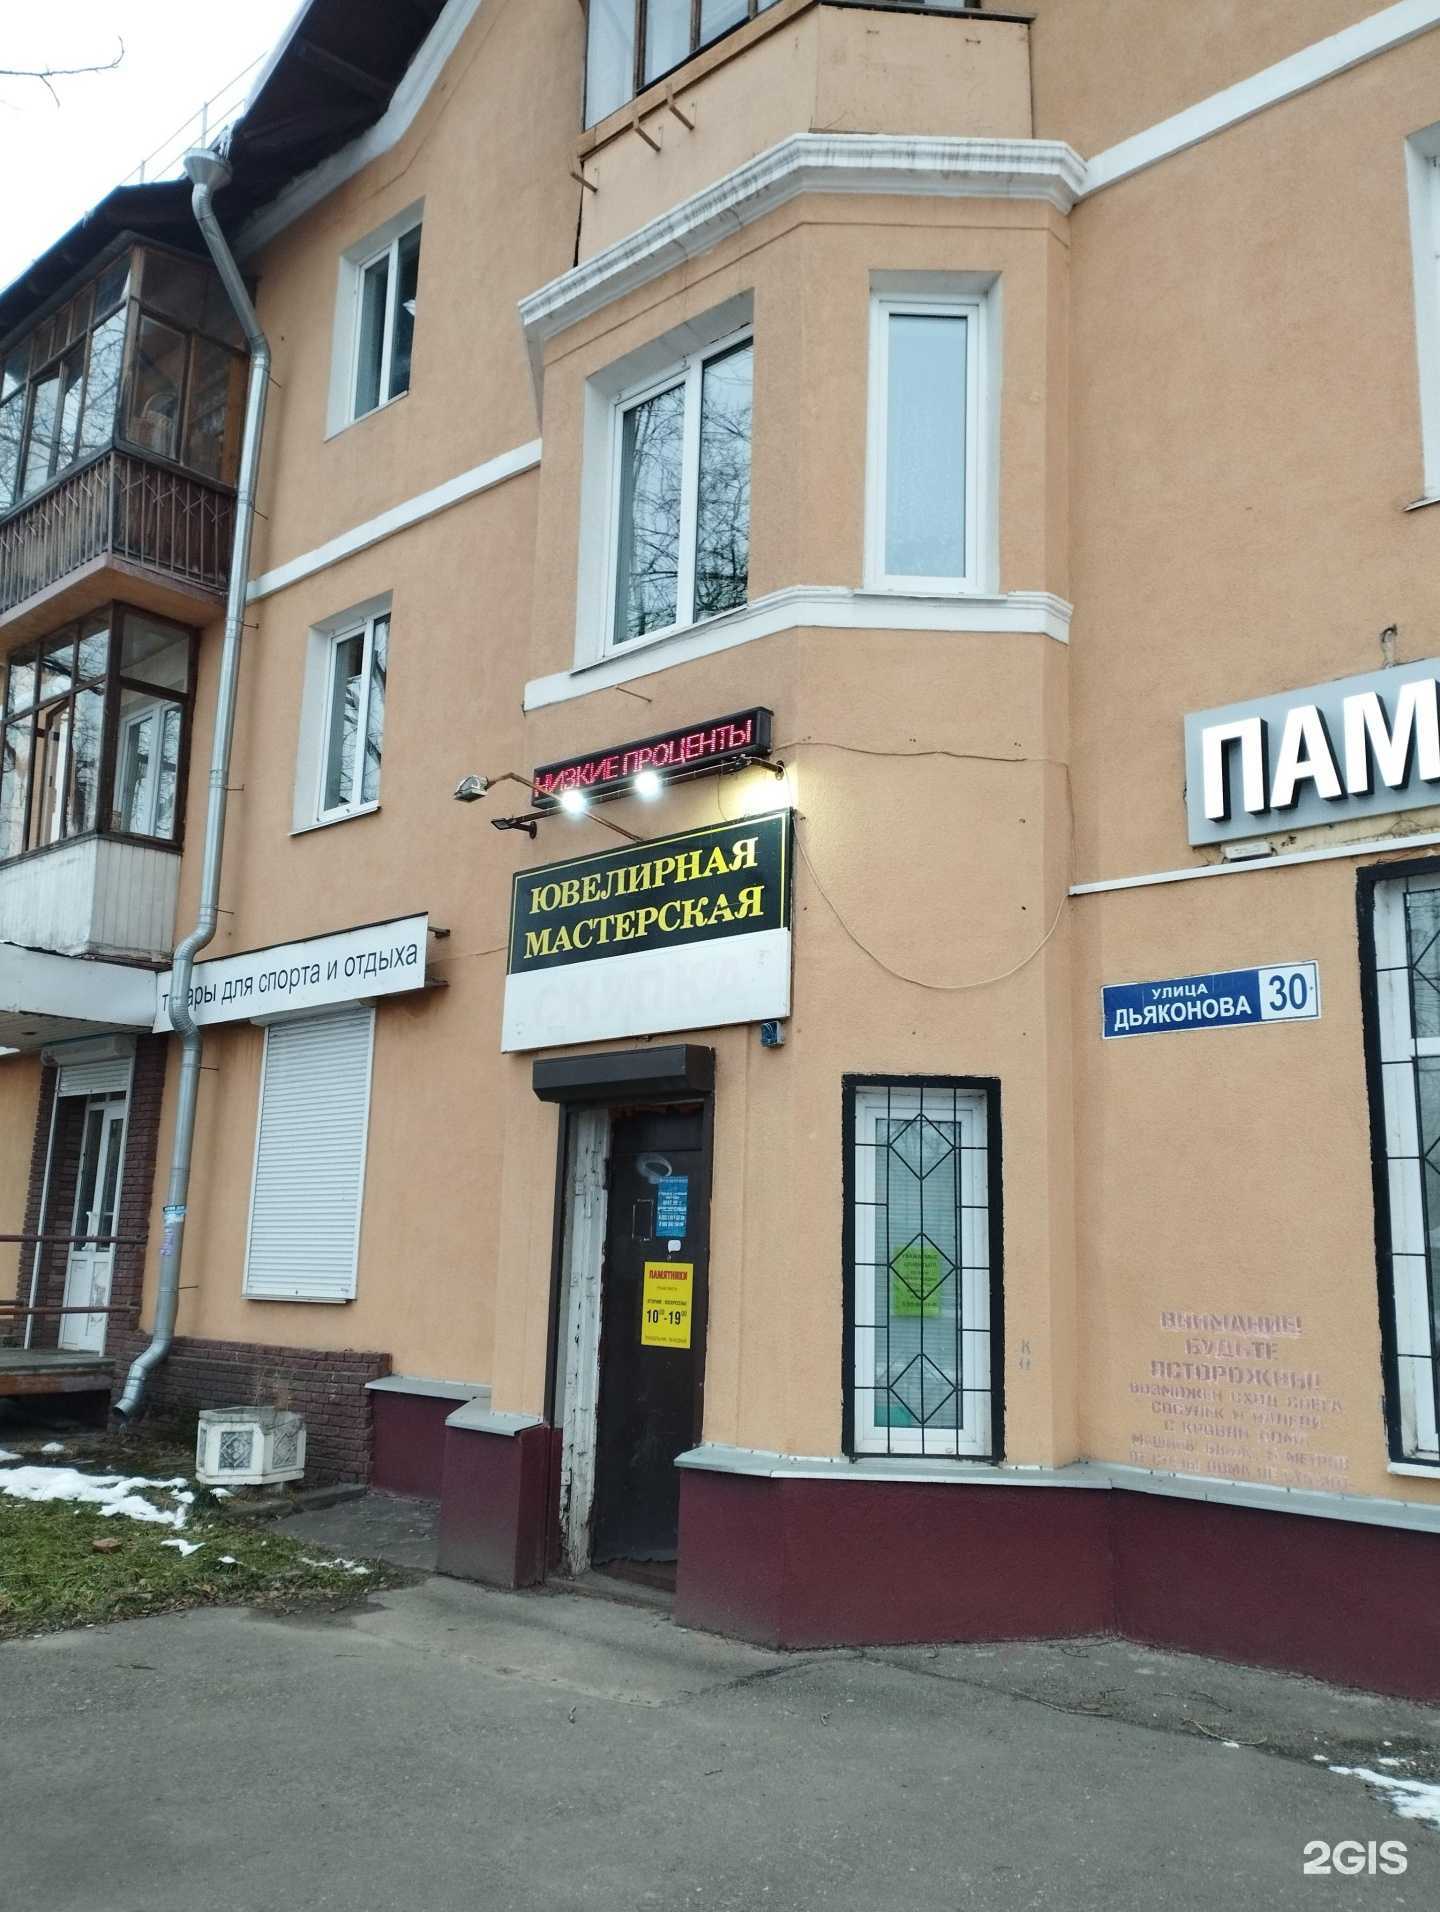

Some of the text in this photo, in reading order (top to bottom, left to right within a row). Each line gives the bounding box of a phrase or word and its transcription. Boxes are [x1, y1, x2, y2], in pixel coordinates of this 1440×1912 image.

[535, 720, 751, 797] НИЗКИЕ ПРОЦЕНТЫ
[529, 837, 758, 914] ЮВЕЛИРНАЯ
[523, 886, 764, 959] МАСТЕРСКАЯ
[162, 944, 417, 1012] тары для спорта и отдыха
[1114, 973, 1307, 1031] ДЬЯКОНОВА 30
[1152, 983, 1208, 999] УЛИЦА
[1160, 1312, 1303, 1334] ВНИМАНИЕ!
